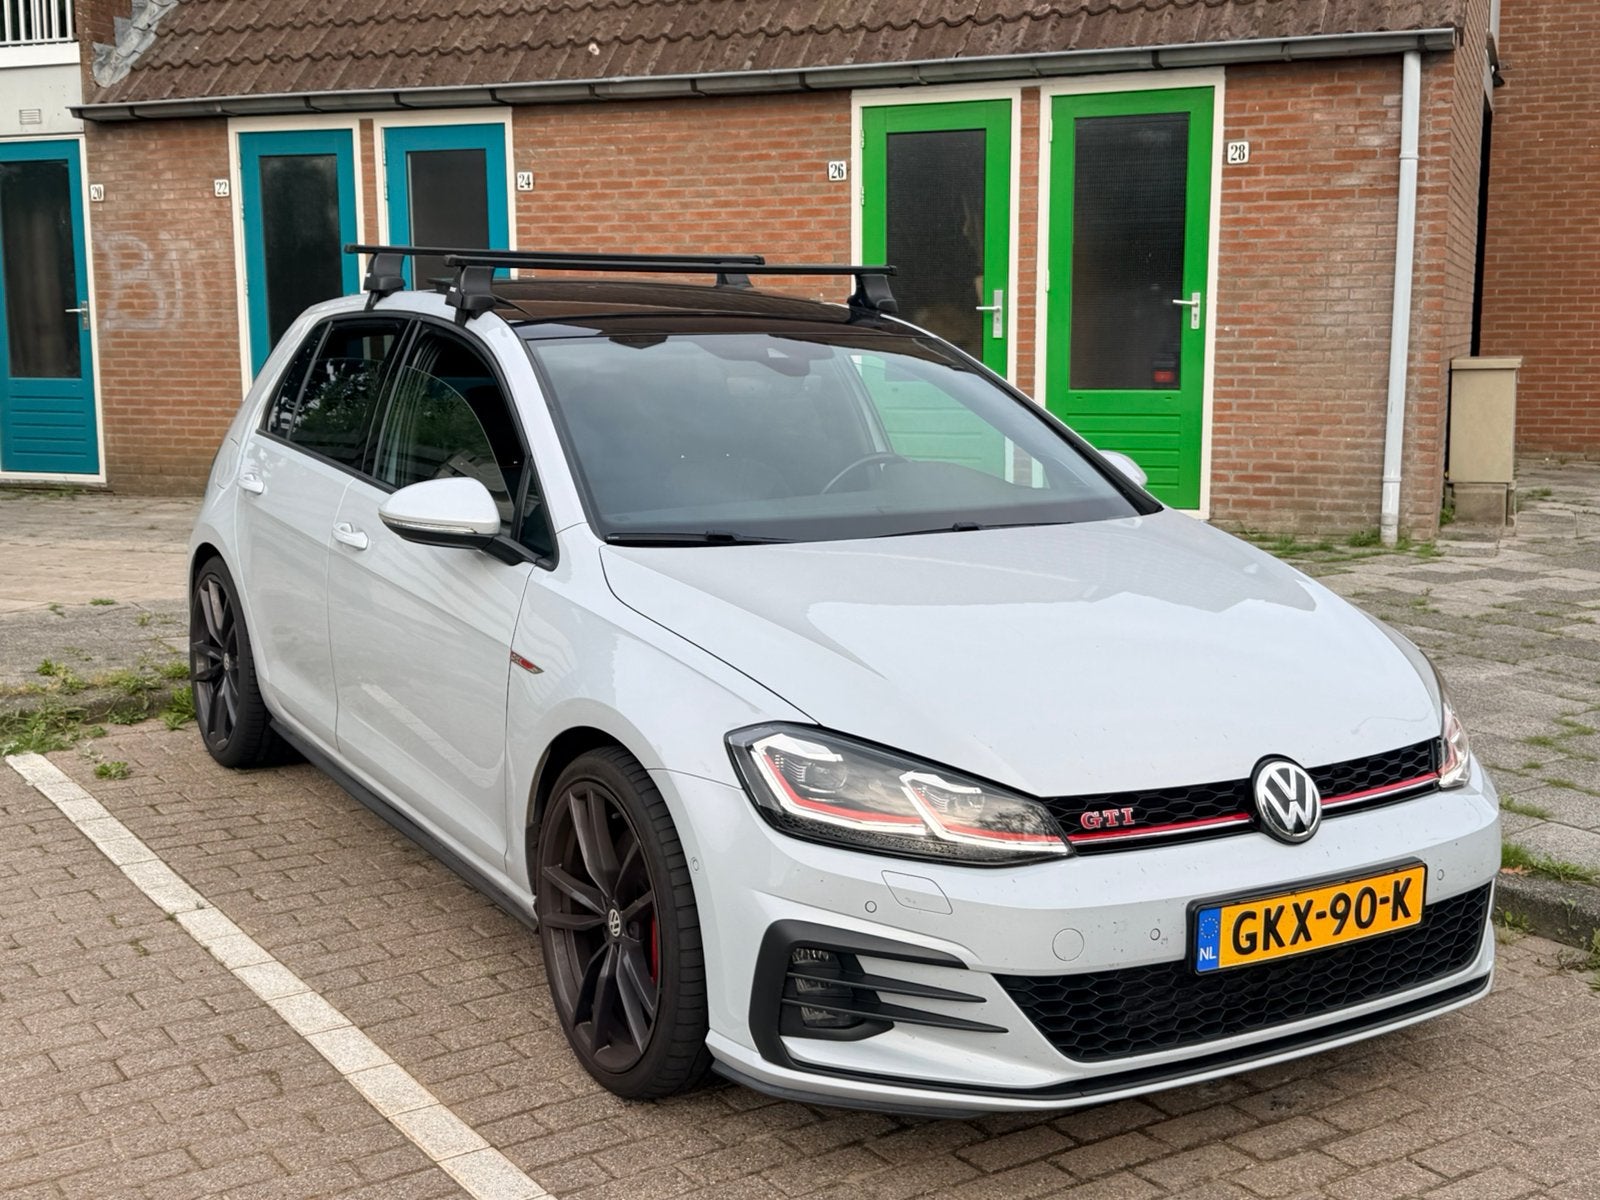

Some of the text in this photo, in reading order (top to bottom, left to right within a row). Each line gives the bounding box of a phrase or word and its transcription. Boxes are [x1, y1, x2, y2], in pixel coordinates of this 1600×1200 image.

[1230, 144, 1246, 161] 28
[830, 163, 844, 179] 26
[216, 181, 228, 195] 22
[519, 174, 531, 189] 24
[91, 186, 102, 200] 20
[1256, 761, 1321, 841] VW
[1080, 807, 1136, 830] GTI
[1232, 877, 1412, 956] GKX-90-K
[1200, 946, 1217, 961] NL
